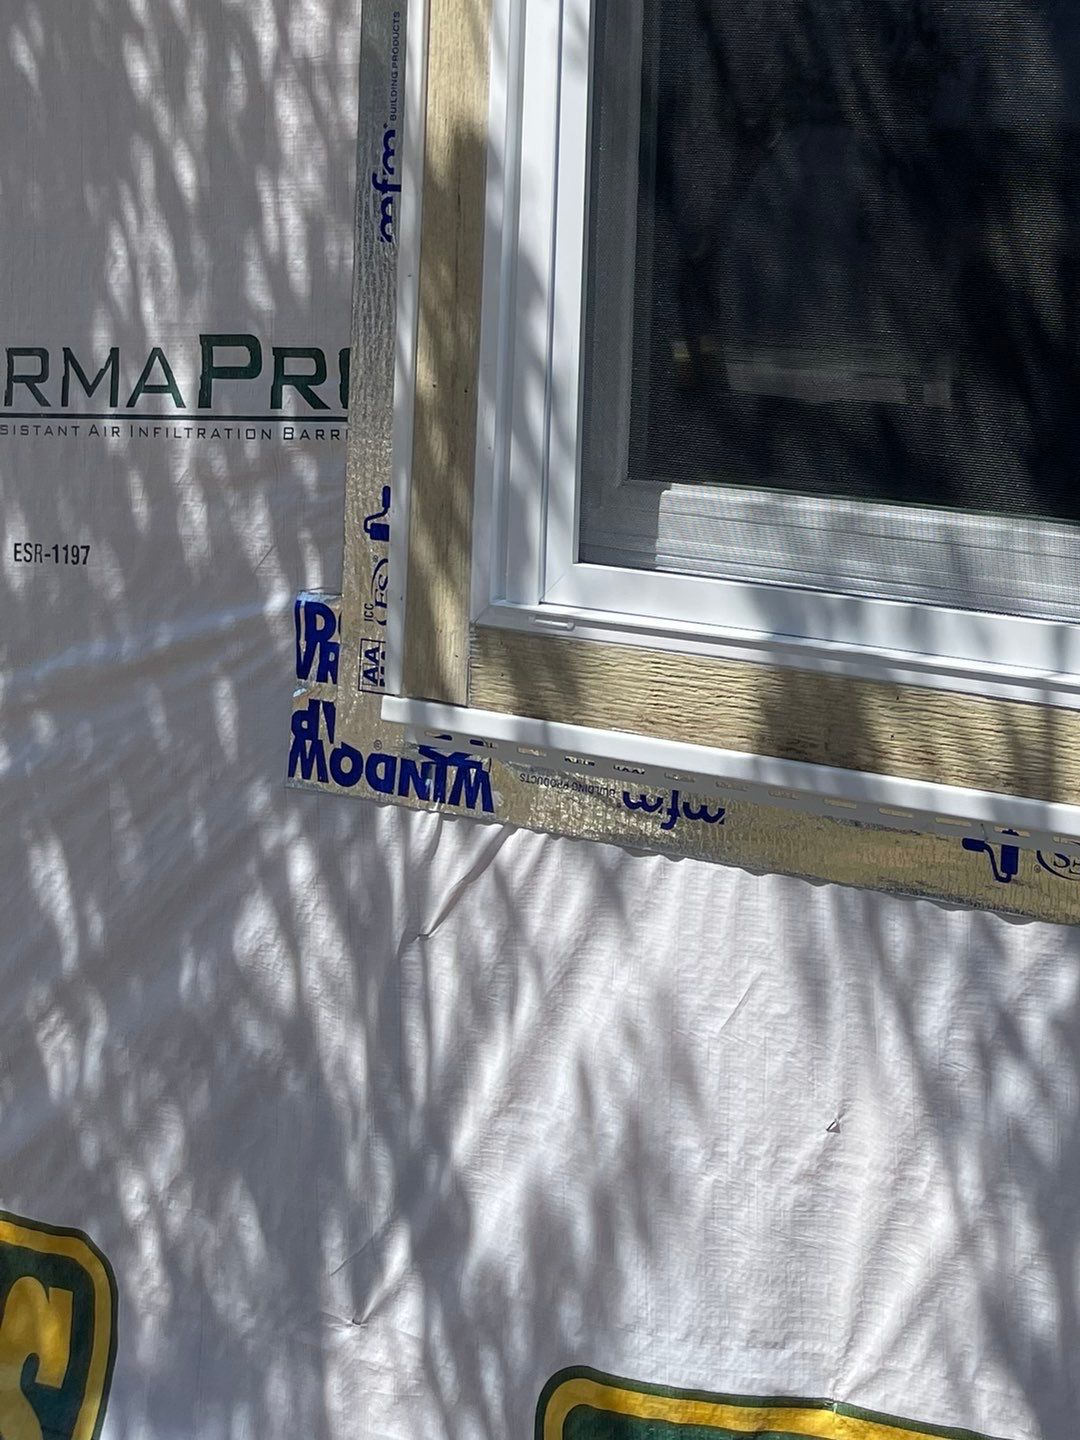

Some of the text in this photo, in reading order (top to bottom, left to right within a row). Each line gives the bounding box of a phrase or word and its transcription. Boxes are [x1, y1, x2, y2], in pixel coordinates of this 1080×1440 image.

[390, 11, 400, 121] BUILDING PRODUCTS
[4, 334, 349, 409] RMAPR
[13, 542, 91, 566] ESR-1197
[287, 739, 495, 813] WINDOW
[519, 773, 570, 793] PRODUCTS
